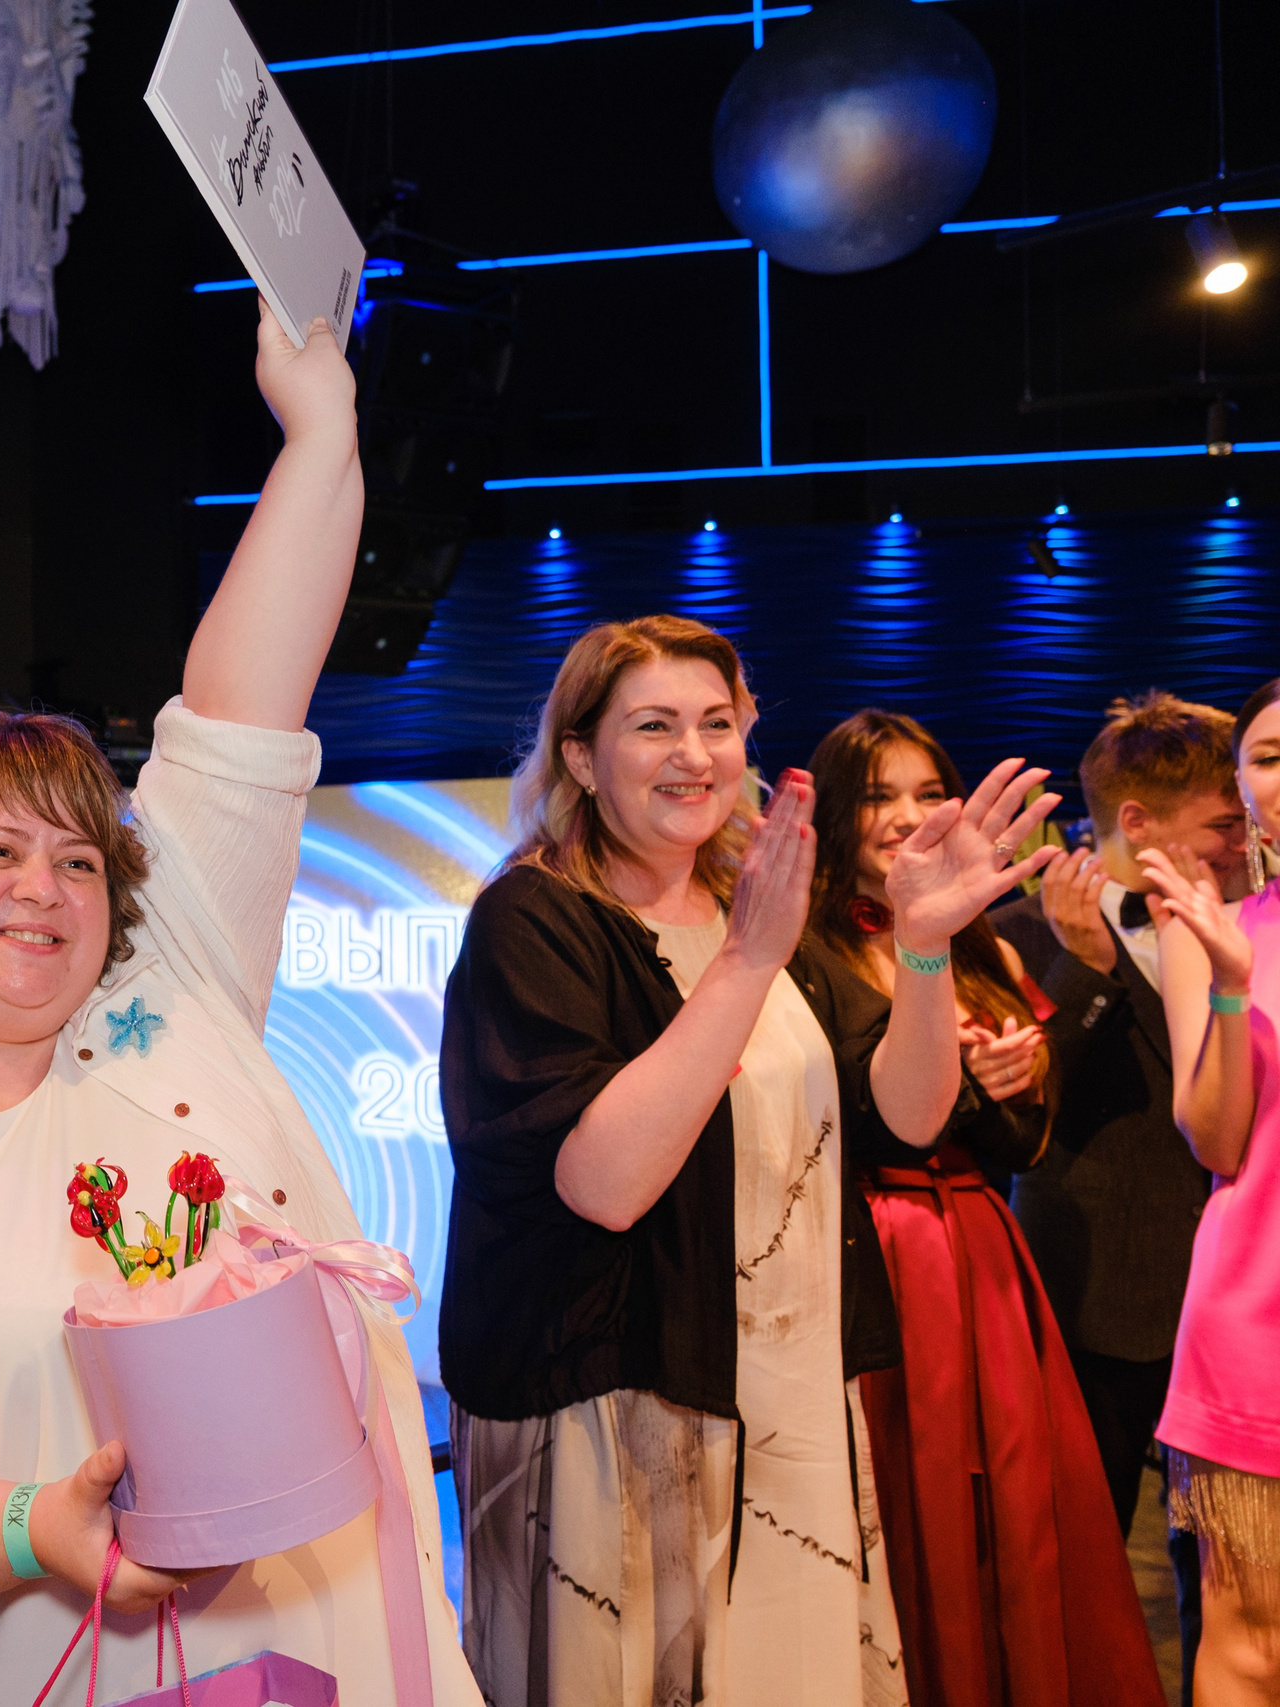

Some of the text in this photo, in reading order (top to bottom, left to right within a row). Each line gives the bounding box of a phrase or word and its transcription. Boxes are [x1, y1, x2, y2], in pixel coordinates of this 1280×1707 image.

[282, 909, 466, 988] ВЫП
[353, 1053, 448, 1140] 20
[7, 1483, 38, 1528] ЖИЗНЬ
